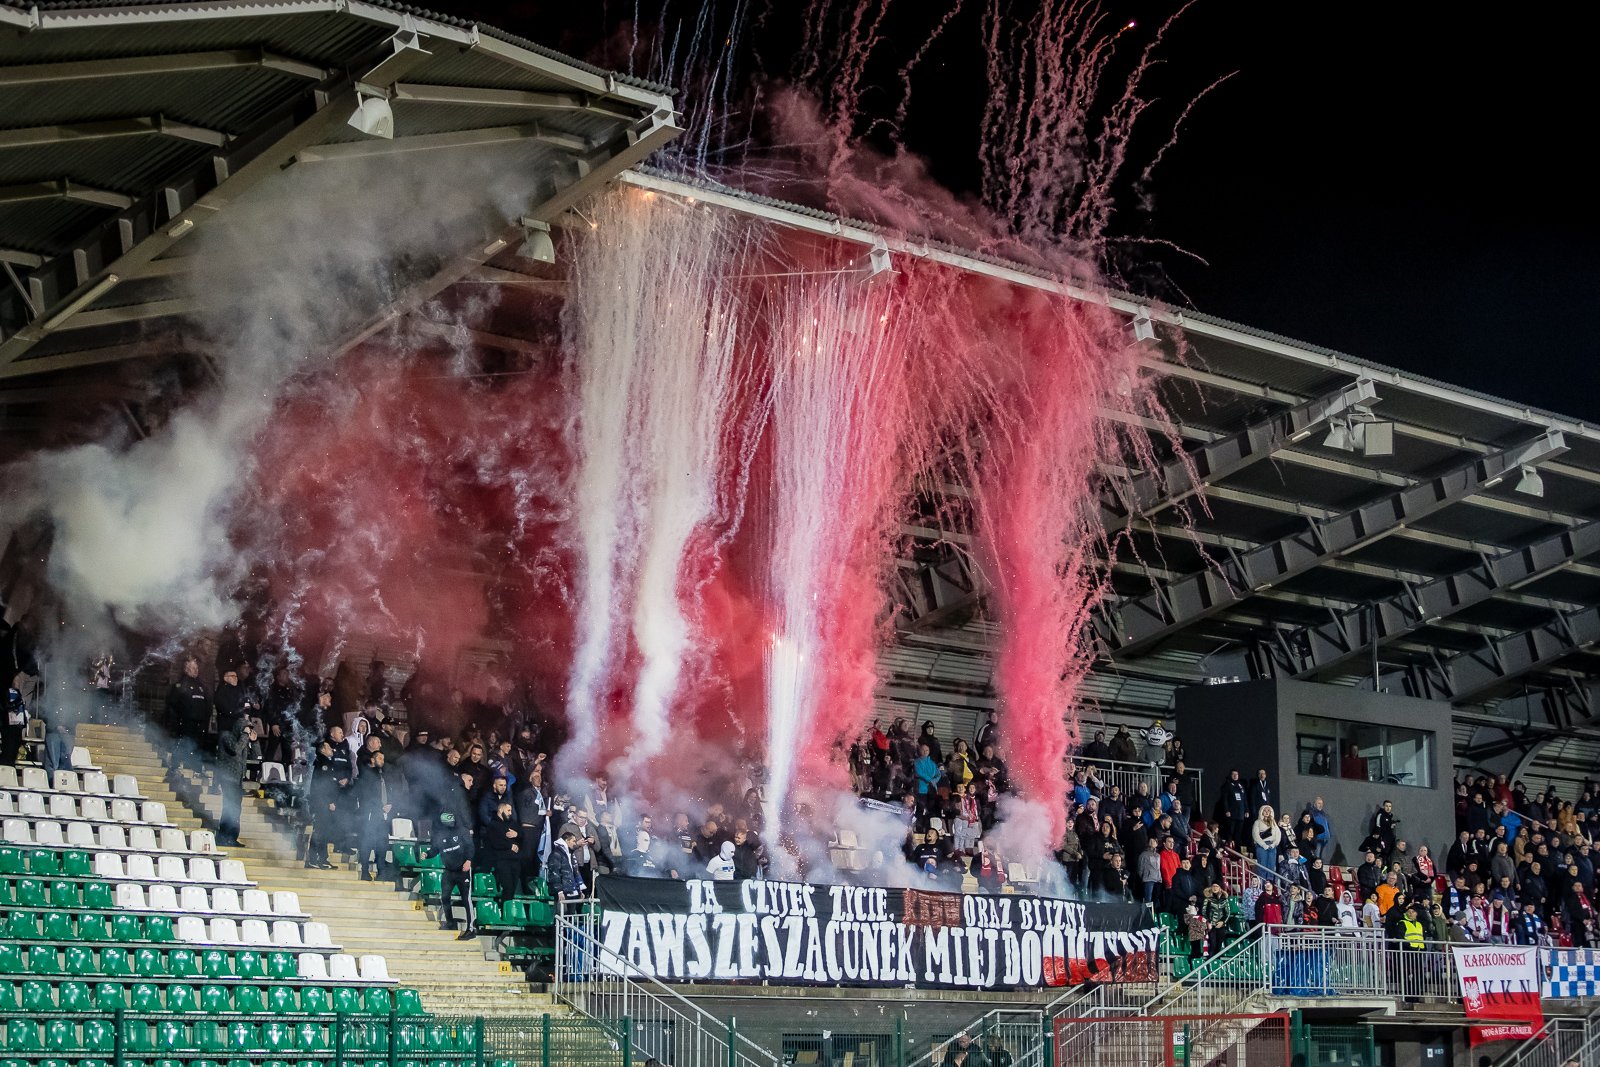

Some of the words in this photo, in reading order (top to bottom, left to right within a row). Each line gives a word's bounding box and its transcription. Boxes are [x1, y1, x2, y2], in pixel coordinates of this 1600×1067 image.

[686, 879, 722, 914] ZA
[963, 895, 1012, 929] ORAZ
[1019, 899, 1086, 934] BLIZNY
[600, 910, 760, 977] ZAWSZE
[761, 915, 916, 982] SZACUNEK
[925, 926, 999, 987] MIEJ
[1003, 930, 1042, 986] DO
[1463, 953, 1526, 967] KARKONOSKI
